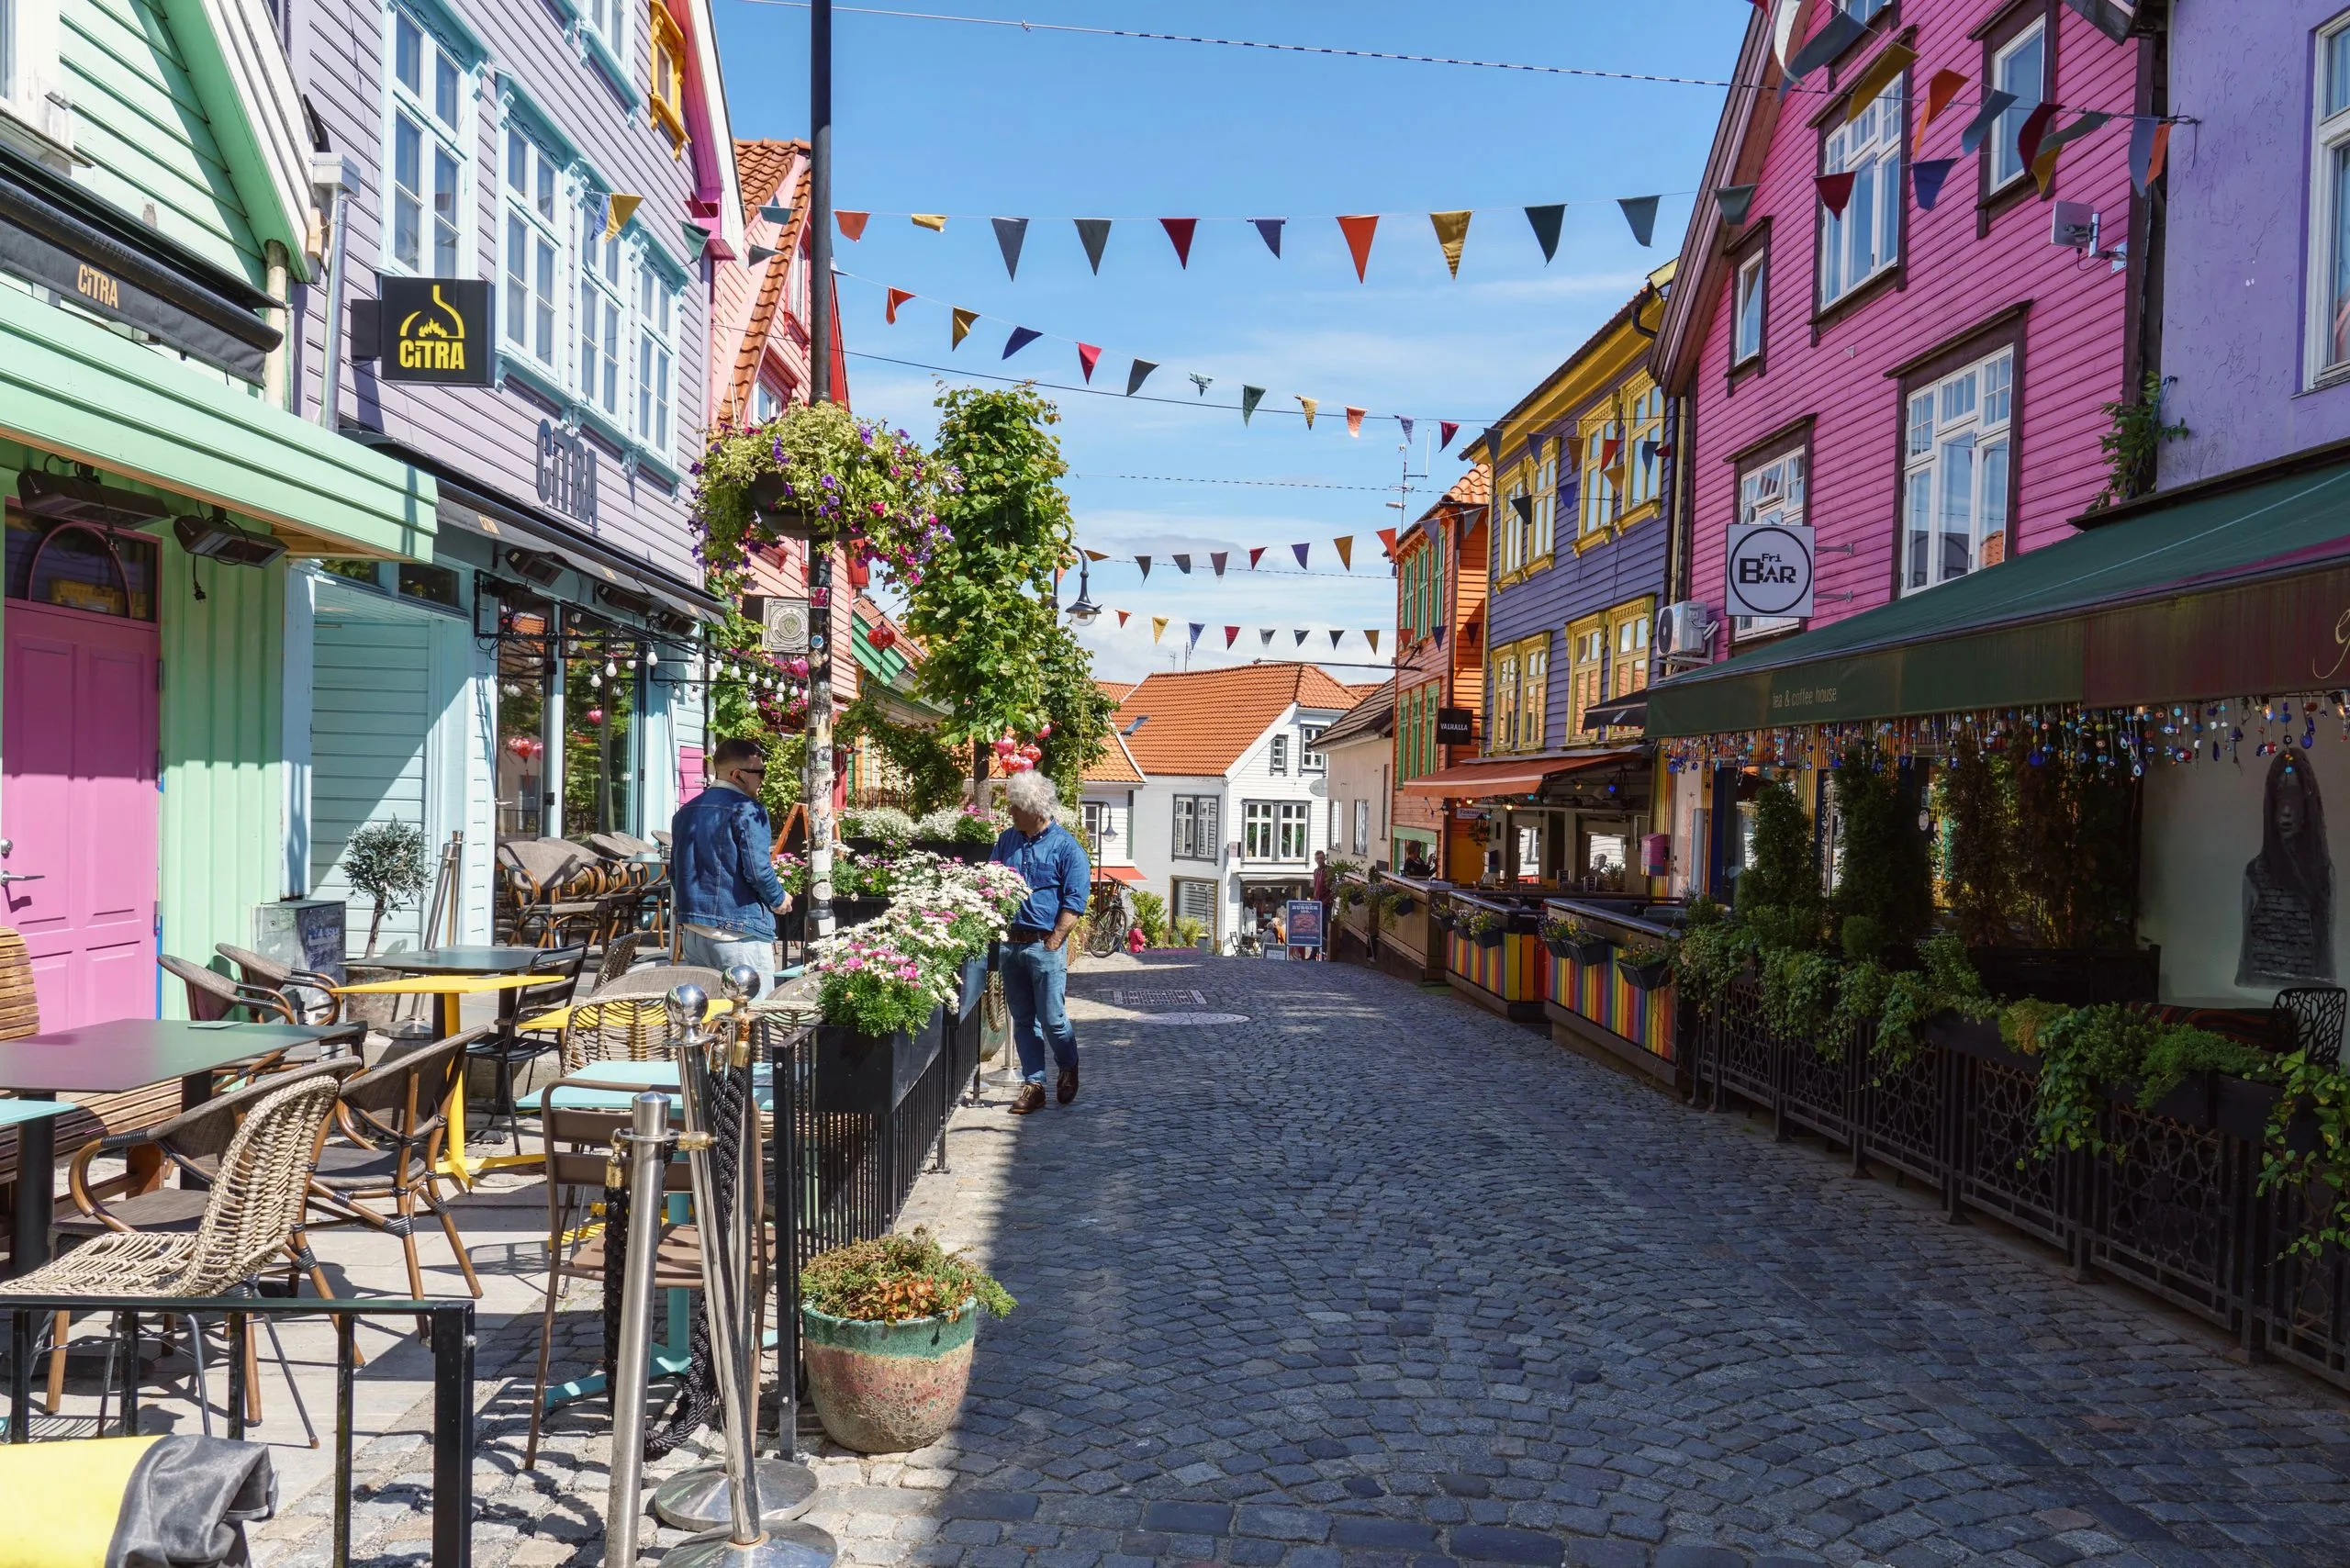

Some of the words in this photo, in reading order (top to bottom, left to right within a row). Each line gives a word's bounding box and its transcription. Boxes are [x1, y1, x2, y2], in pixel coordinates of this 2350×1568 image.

[1762, 553, 1782, 563] Fri
[1739, 557, 1796, 584] BAR
[1791, 687, 1813, 706] coffee
[1815, 686, 1837, 703] house
[1440, 722, 1468, 731] VALHALLA
